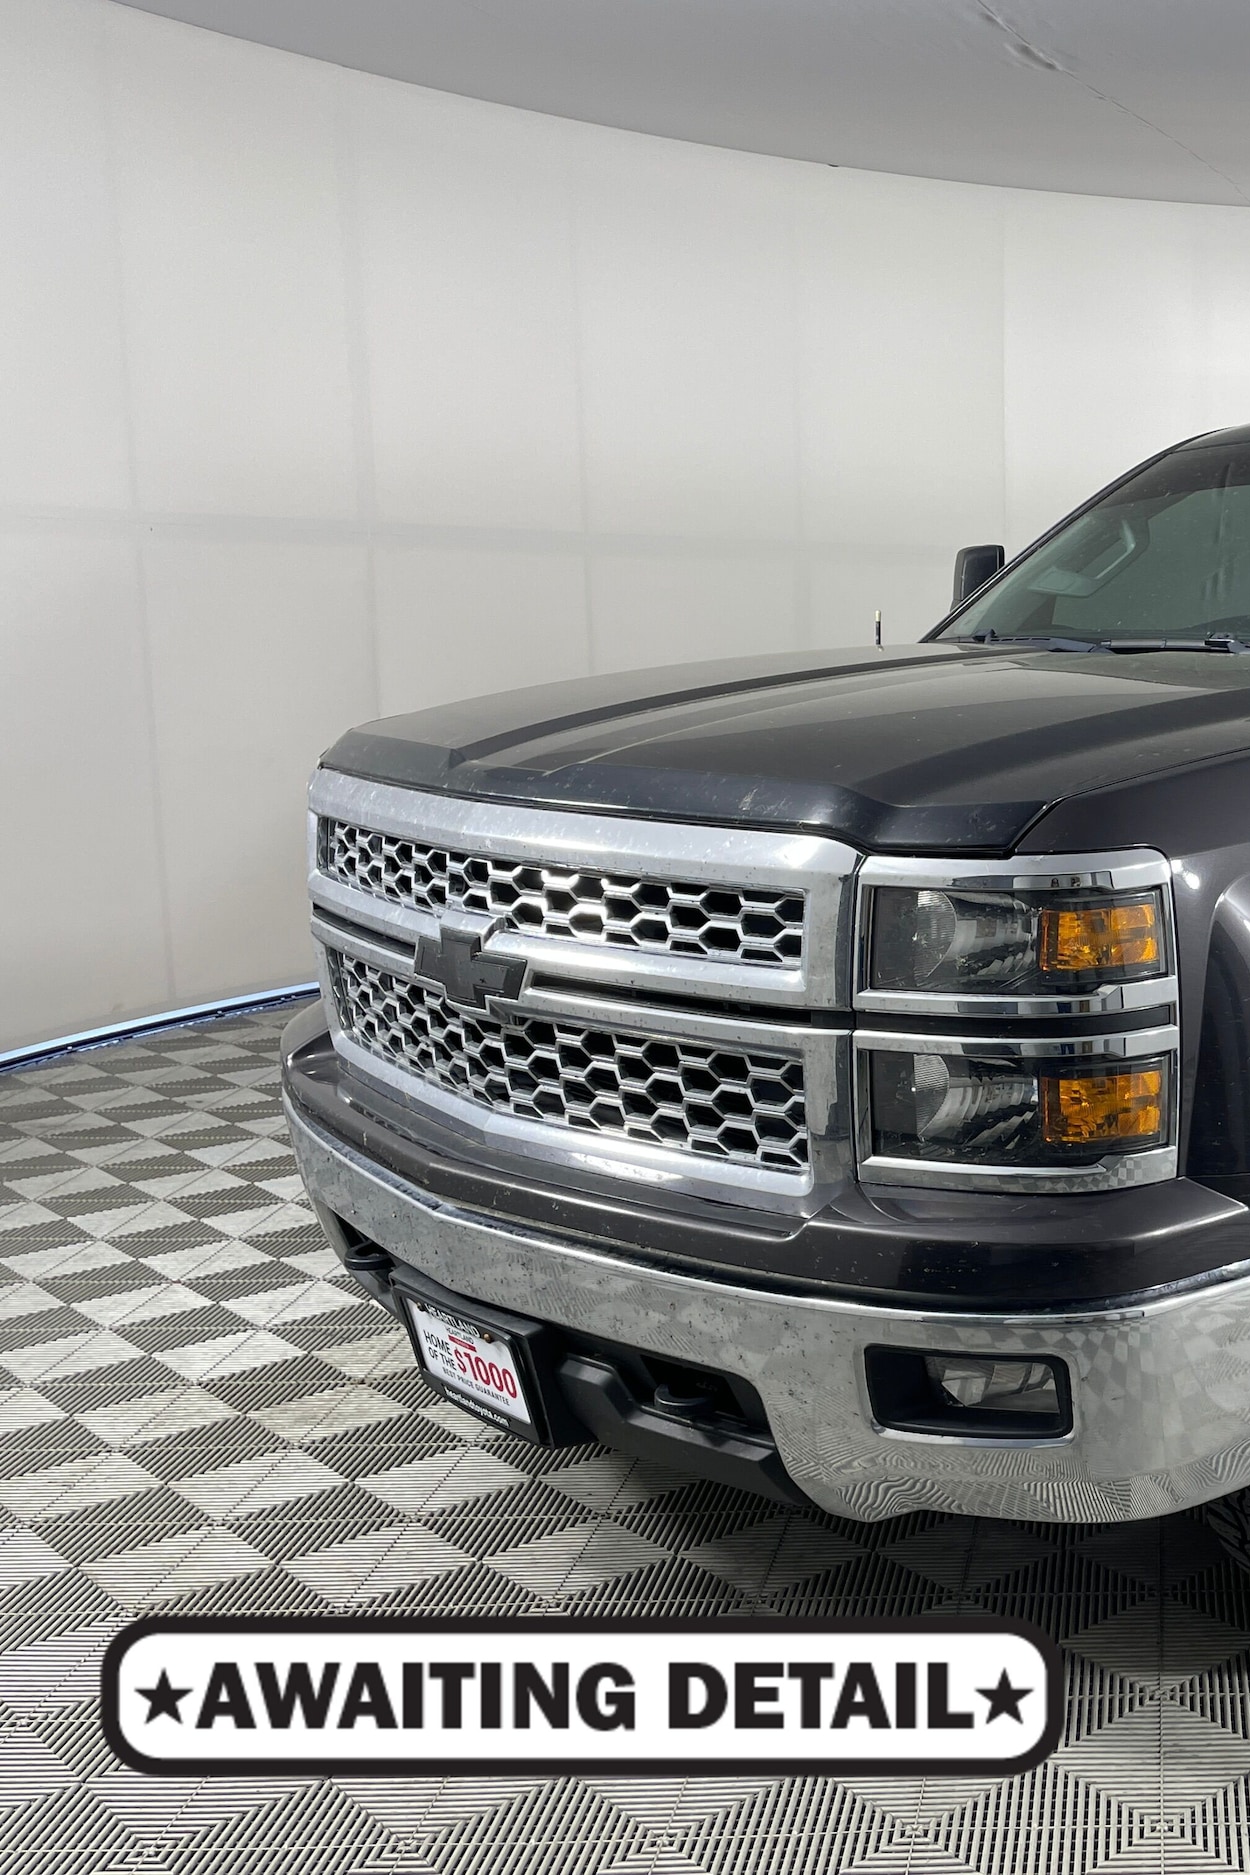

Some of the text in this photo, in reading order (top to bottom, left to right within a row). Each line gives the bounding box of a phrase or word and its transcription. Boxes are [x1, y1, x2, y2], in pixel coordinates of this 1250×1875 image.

[423, 1302, 481, 1339] HEARTLAND
[422, 1329, 453, 1355] HOME
[428, 1347, 457, 1371] OF THE
[442, 1366, 511, 1406] BEST PRICE GUARANTEE
[453, 1346, 518, 1399] $1000
